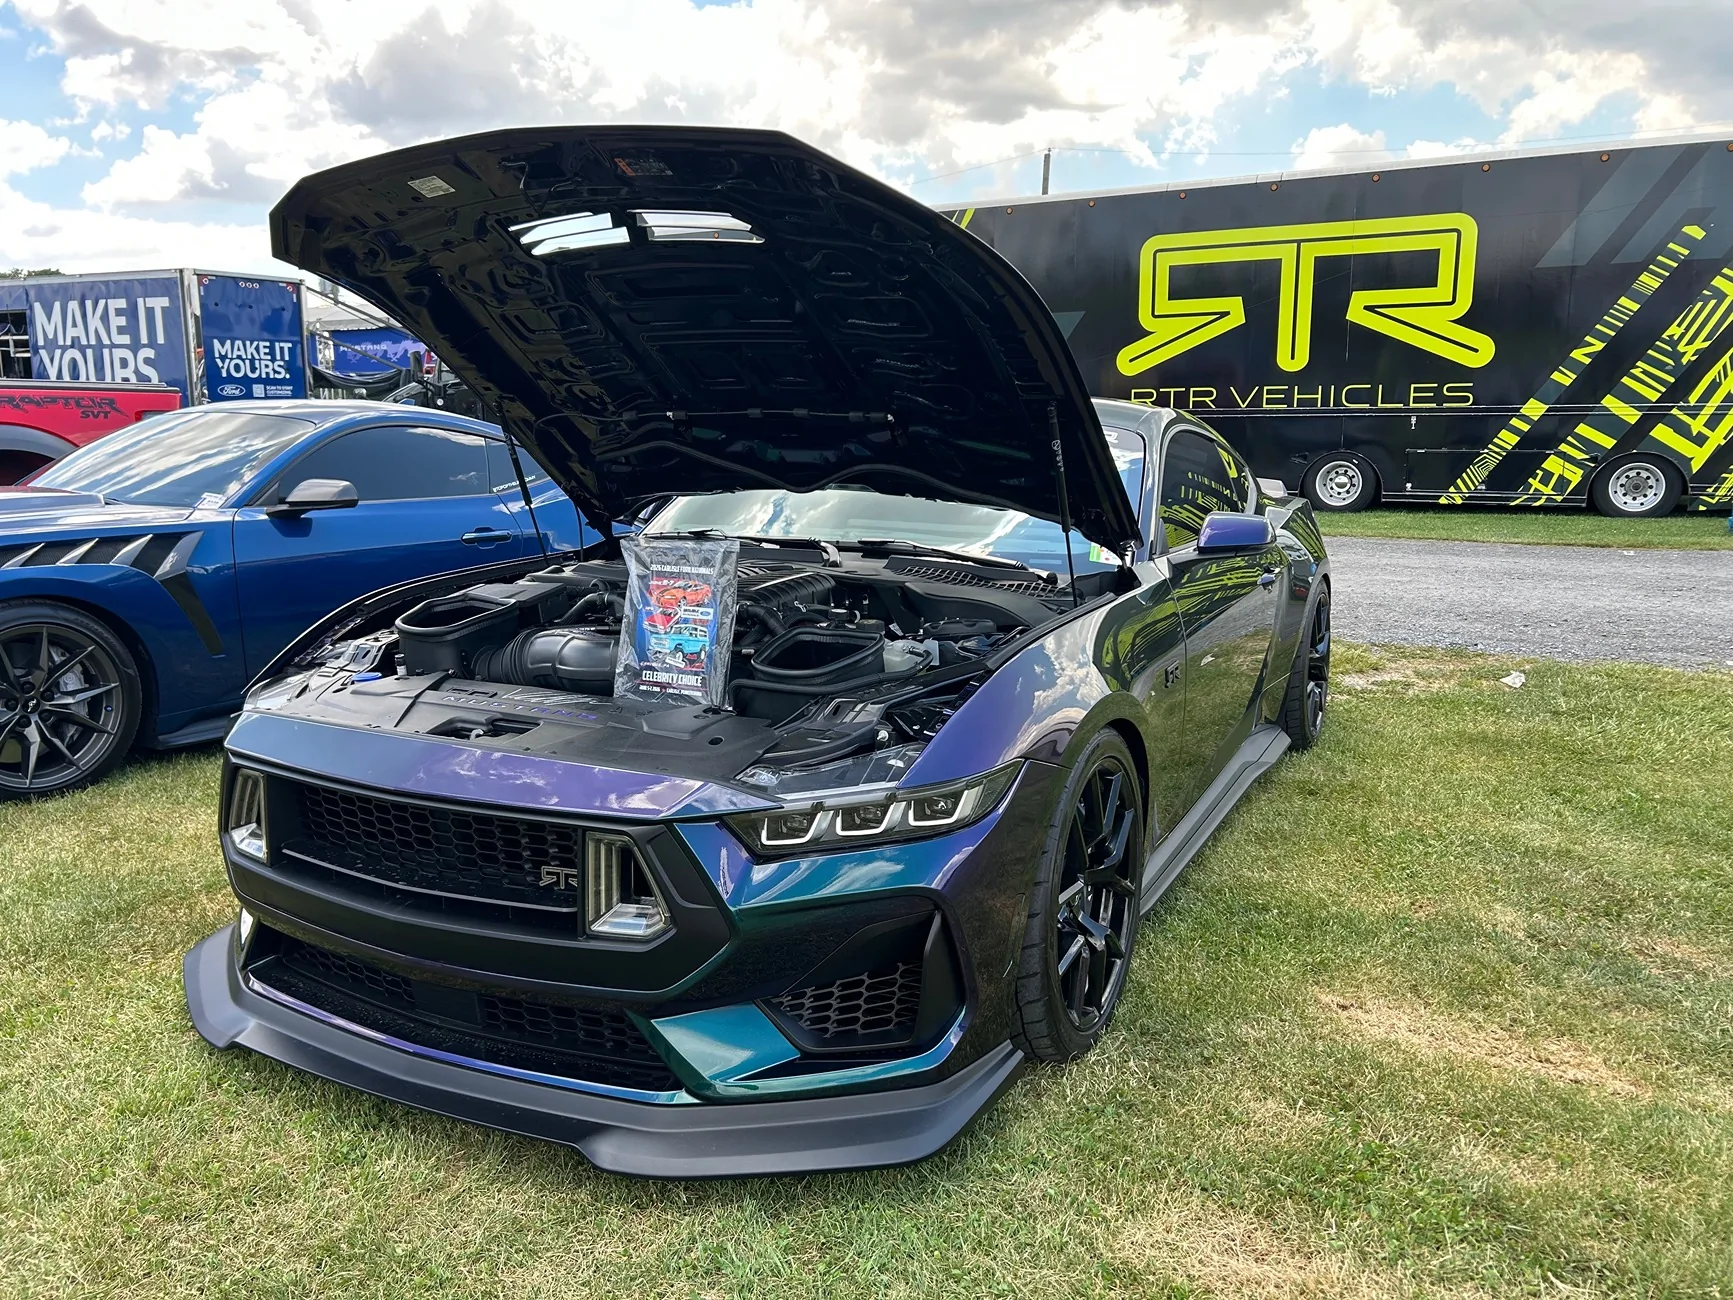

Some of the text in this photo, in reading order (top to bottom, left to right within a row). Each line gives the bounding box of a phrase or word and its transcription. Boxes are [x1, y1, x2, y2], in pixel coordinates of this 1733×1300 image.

[1115, 212, 1496, 376] RTR
[33, 296, 170, 346] MAKE IT
[213, 339, 293, 361] MAKE IT
[215, 358, 291, 379] YOURS.
[1130, 381, 1474, 409] RTR VEHICLES
[80, 410, 111, 420] SVT
[642, 670, 703, 687] CELEBRITY CHOICE
